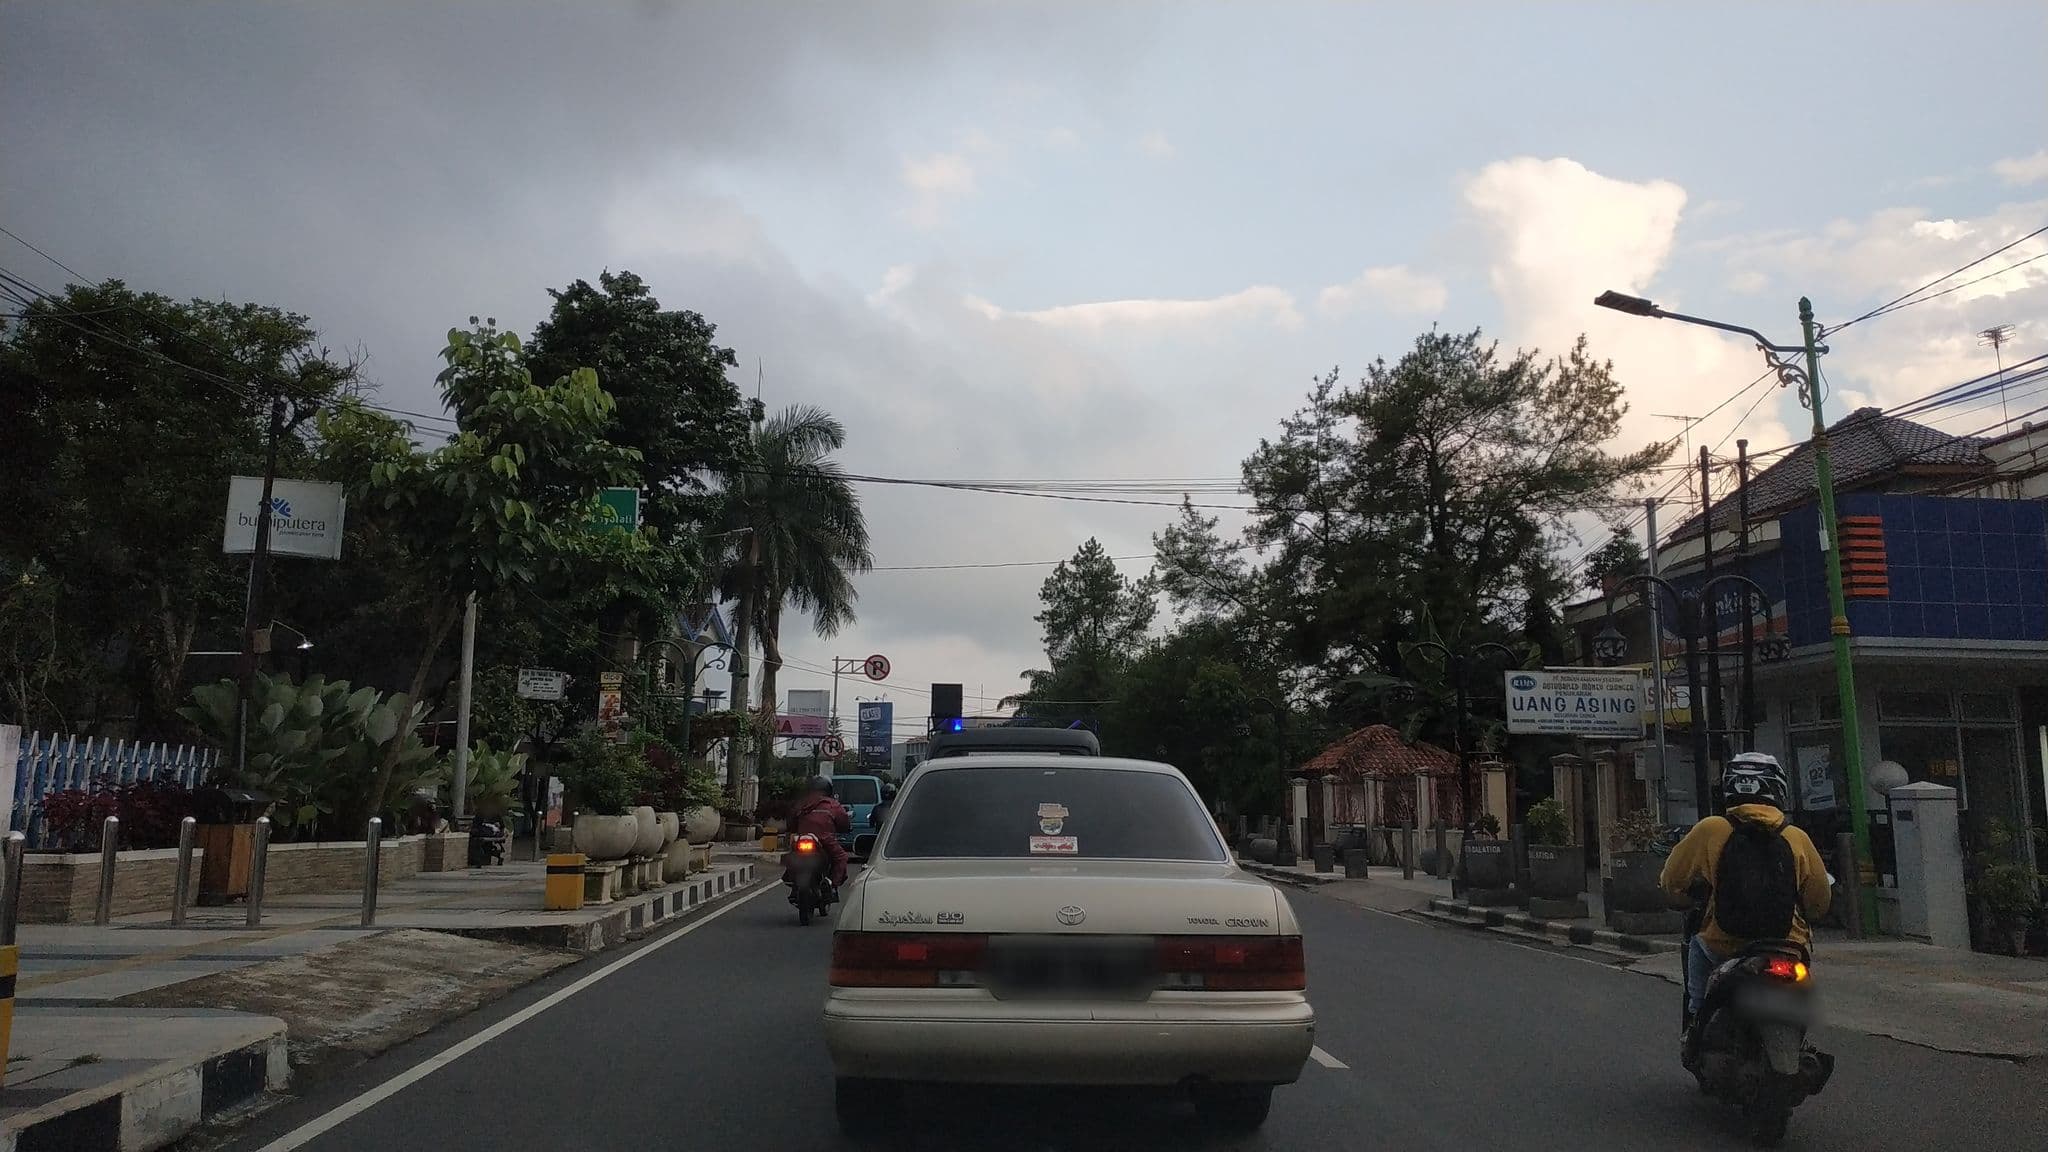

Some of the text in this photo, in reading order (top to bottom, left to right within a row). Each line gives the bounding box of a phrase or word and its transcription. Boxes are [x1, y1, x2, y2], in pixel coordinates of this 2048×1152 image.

[238, 513, 326, 531] buiputera
[1512, 696, 1636, 713] UANG ASING
